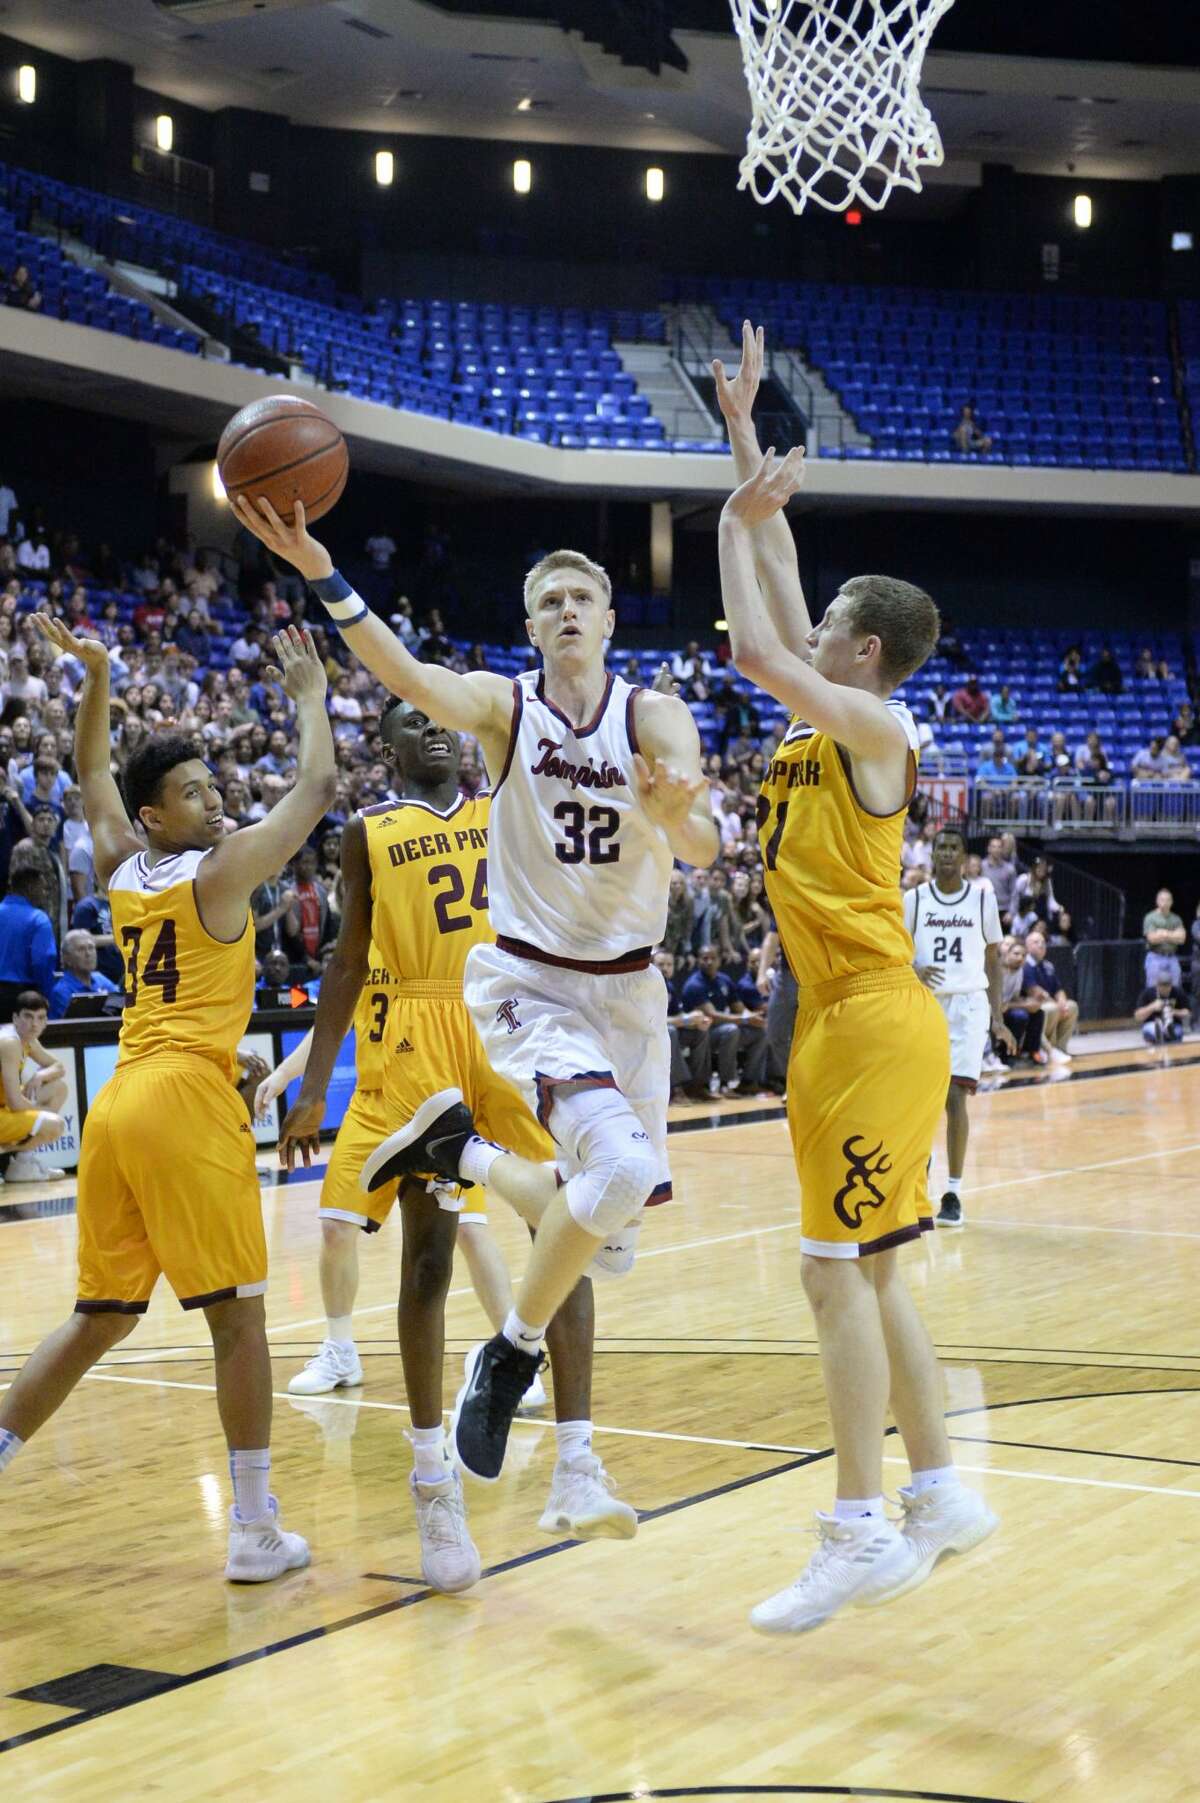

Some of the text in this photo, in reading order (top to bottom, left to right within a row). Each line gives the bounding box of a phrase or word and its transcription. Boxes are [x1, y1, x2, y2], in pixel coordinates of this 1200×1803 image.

[388, 832, 452, 868] DEER
[554, 801, 620, 865] 32
[924, 911, 974, 931] Tompkins
[121, 918, 180, 1009] 34
[933, 936, 962, 963] 24
